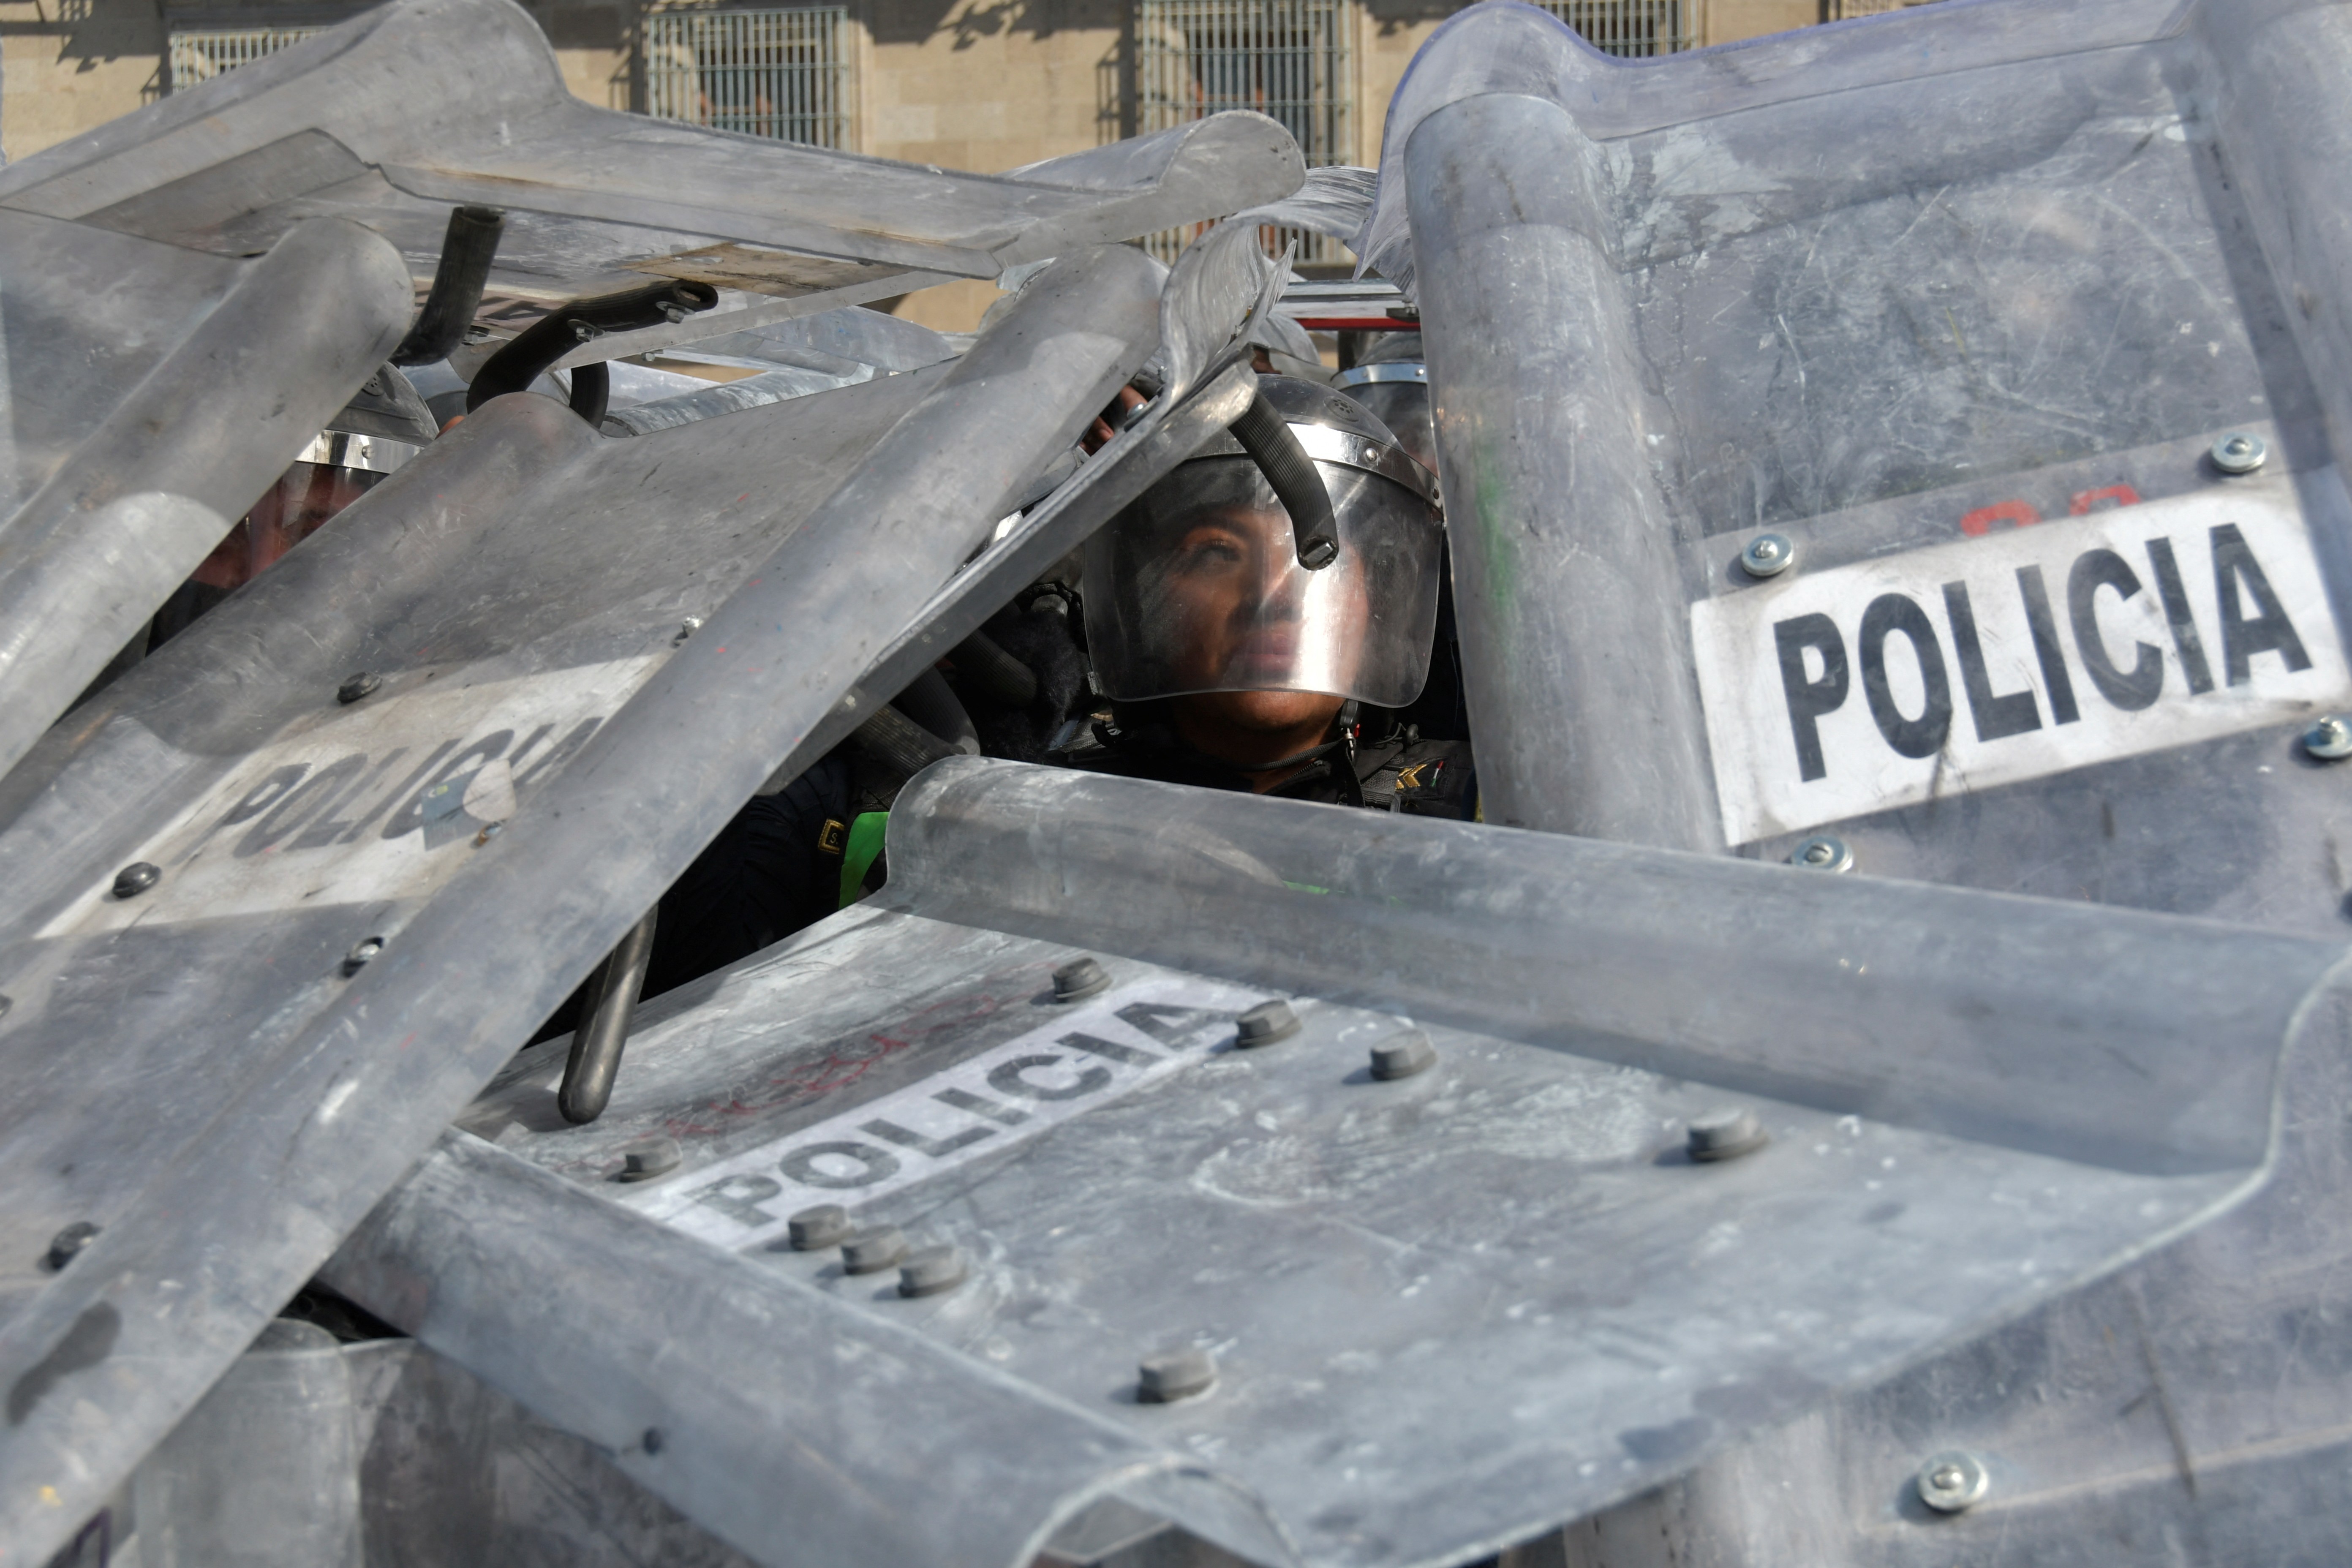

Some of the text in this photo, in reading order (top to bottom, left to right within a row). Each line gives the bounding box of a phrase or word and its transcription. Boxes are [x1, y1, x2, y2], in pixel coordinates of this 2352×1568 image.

[1774, 523, 2313, 782] POLICIA
[169, 716, 605, 858] POLICI
[681, 1001, 1240, 1228] POLICIA
